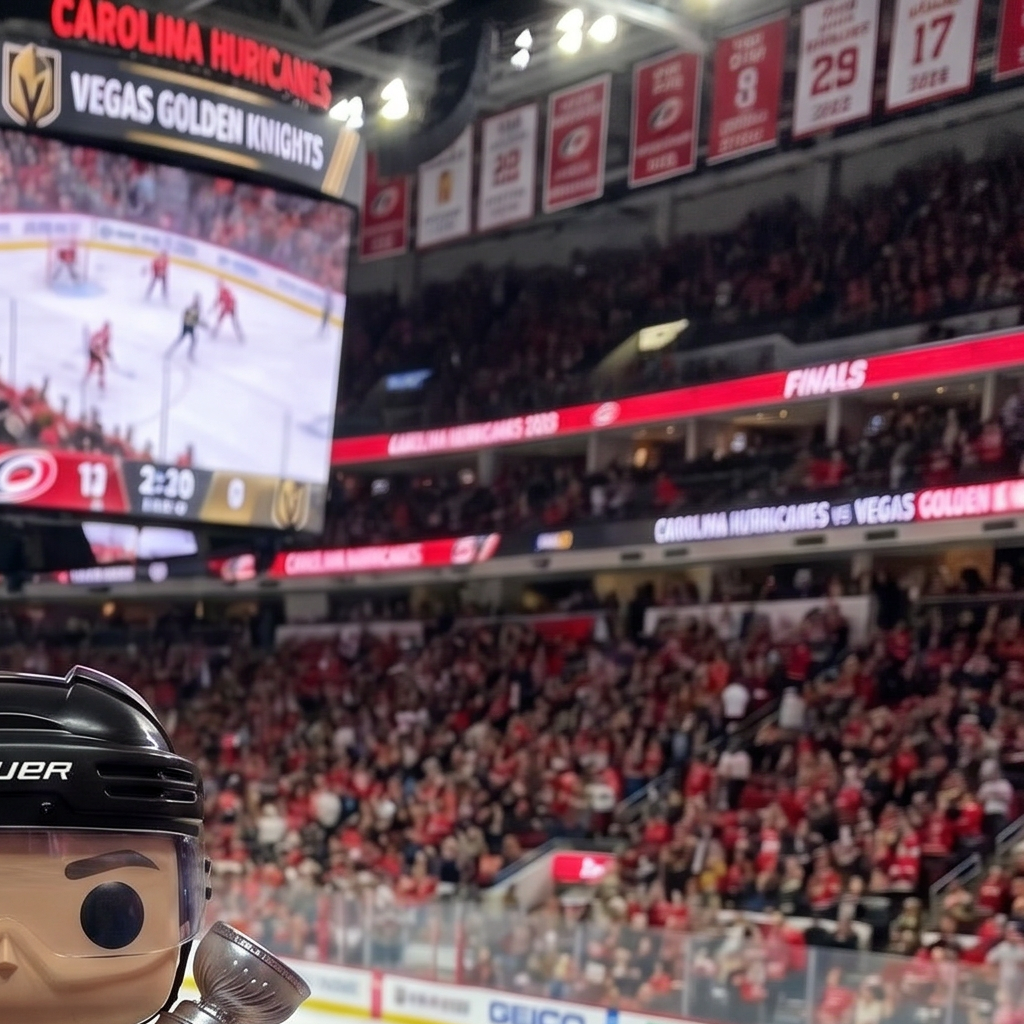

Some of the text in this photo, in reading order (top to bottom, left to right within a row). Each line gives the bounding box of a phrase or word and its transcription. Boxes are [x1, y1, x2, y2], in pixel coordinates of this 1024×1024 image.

[50, 0, 204, 67] CAROLINA
[913, 13, 956, 66] 17
[810, 46, 860, 97] 29
[70, 71, 324, 171] VEGAS GOLDEN KNIGHTS
[783, 359, 869, 399] FINALS
[854, 492, 916, 525] VEGAS
